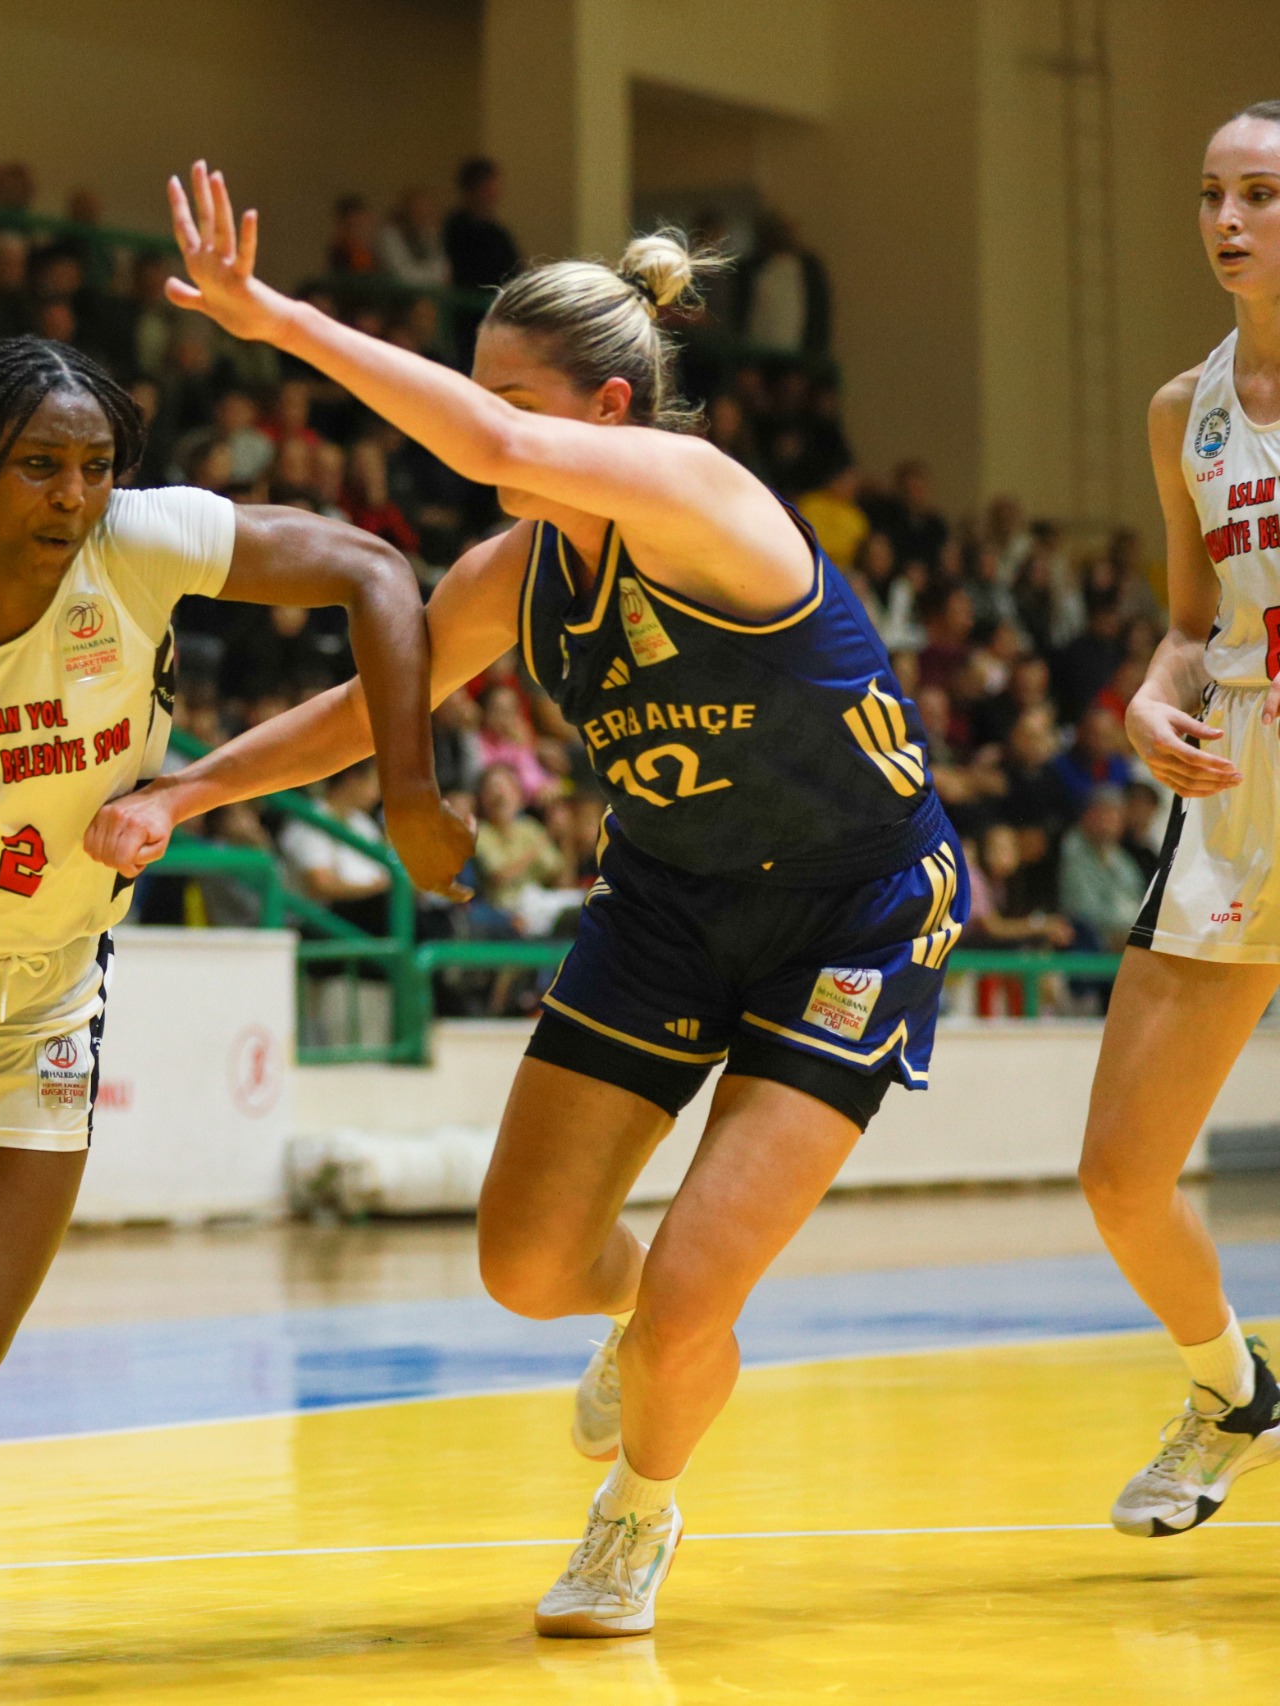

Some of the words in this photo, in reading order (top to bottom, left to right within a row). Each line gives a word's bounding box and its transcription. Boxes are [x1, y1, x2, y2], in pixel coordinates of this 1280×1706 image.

[1196, 467, 1224, 482] upa
[1227, 476, 1276, 511] ASLAN
[71, 636, 117, 652] HALKBANK
[65, 654, 118, 672] BASKETBOL
[24, 698, 68, 731] YOL
[583, 702, 757, 751] ERBAHÇE
[0, 735, 87, 785] BELEDİYE
[93, 718, 131, 766] SPOR
[606, 743, 735, 809] 12
[1210, 912, 1242, 924] upa
[826, 991, 869, 1013] HALKBANK
[810, 1003, 861, 1030] BASKETBOL
